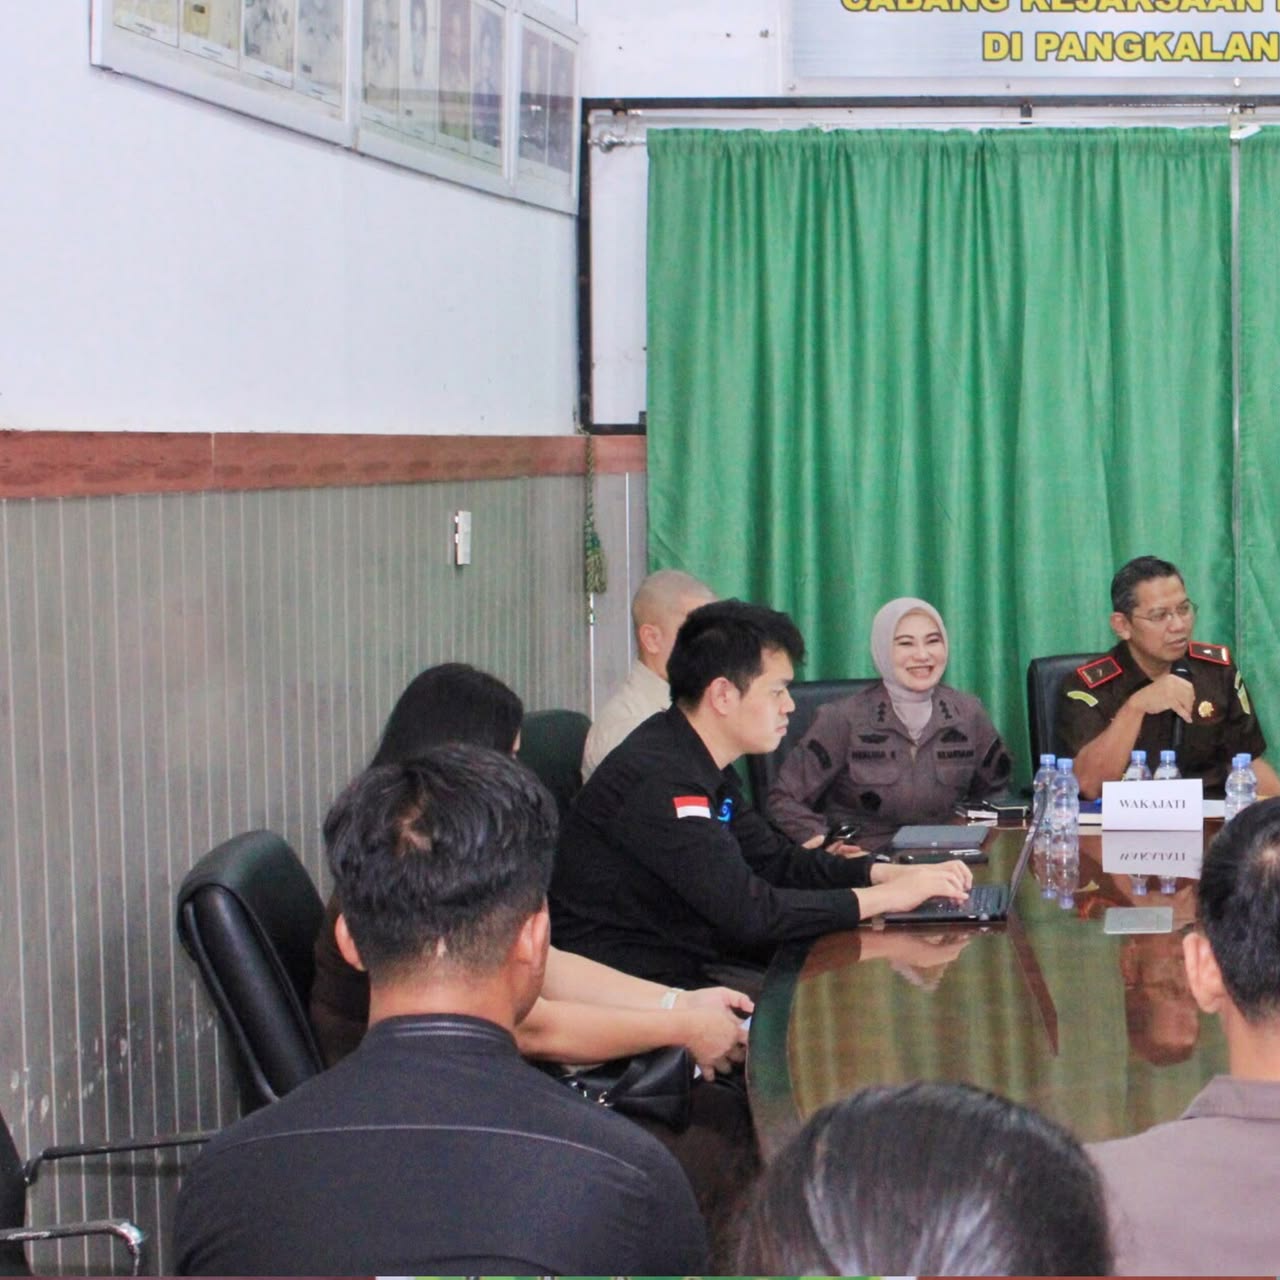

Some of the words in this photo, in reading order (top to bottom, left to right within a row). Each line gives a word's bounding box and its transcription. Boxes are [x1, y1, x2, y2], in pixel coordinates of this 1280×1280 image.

[982, 32, 1023, 61] DI
[1035, 32, 1280, 62] PANGKALAN
[1119, 799, 1187, 809] WAKAJATI
